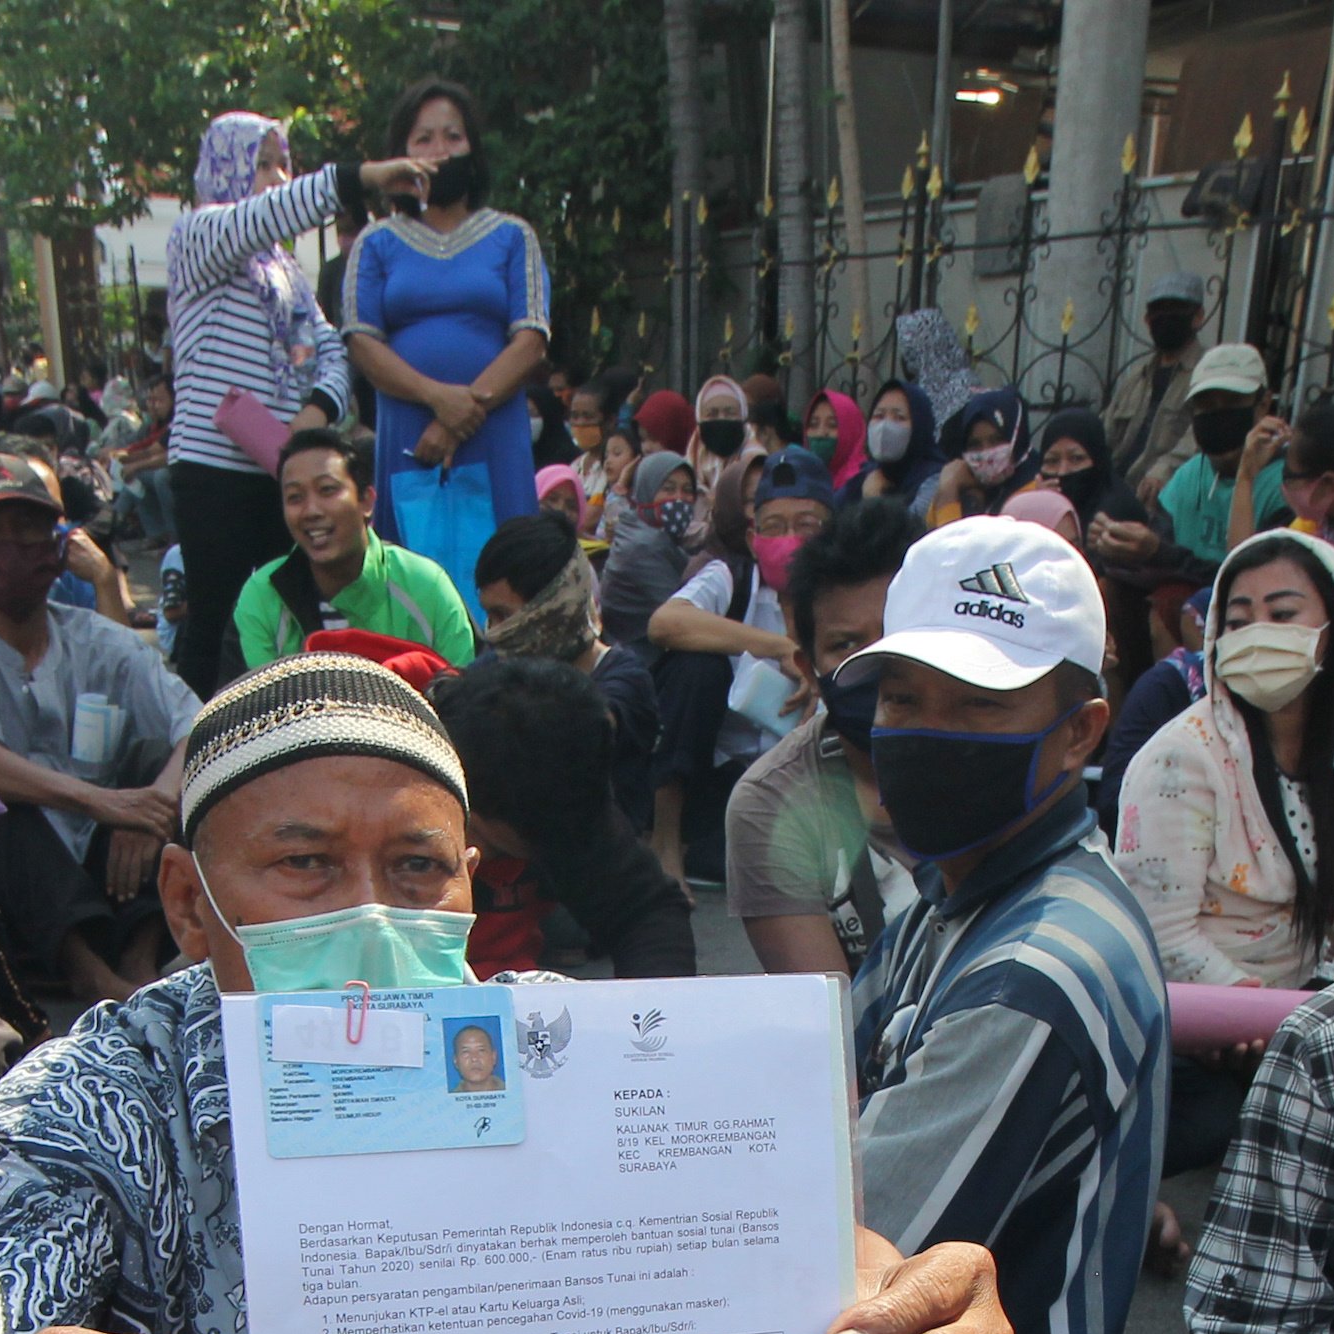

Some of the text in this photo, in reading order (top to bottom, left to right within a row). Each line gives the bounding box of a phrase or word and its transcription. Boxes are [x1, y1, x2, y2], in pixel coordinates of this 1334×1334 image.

[954, 600, 1025, 629] adidas
[382, 993, 407, 1001] JAWA
[408, 992, 434, 1000] TIMUR
[378, 1001, 423, 1010] SURABAYA
[614, 1089, 664, 1101] KEPADA
[615, 1106, 666, 1118] SUKILAN
[617, 1123, 670, 1135] KALIANAK
[676, 1121, 709, 1132] TIMUR
[618, 1131, 776, 1148] 8/19 KEL MOROKREMBANGAN
[618, 1143, 777, 1161] KEC KREMBANGAN KOTA
[619, 1161, 677, 1174] SURABAYA
[299, 1224, 345, 1236] Dengan
[300, 1235, 374, 1249] Berdasarkan
[377, 1232, 439, 1246] Keputusan
[443, 1226, 507, 1240] Pemerintah
[510, 1223, 558, 1238] Republik
[562, 1220, 613, 1232] Indonesia
[639, 1214, 698, 1226] Kementrian
[702, 1211, 733, 1223] Sosial
[736, 1208, 779, 1224] Republik
[457, 1240, 517, 1255] dinyatakan
[520, 1237, 558, 1249] berhak
[562, 1232, 628, 1247] memperoleh
[631, 1230, 674, 1241] bantuan
[678, 1226, 707, 1238] sosial
[710, 1226, 736, 1236] tunai
[739, 1223, 779, 1235] (Bansos
[304, 1265, 335, 1278] Tunai
[342, 1264, 377, 1275] Tahun
[381, 1260, 415, 1273] 2020)
[419, 1258, 456, 1270] senilai
[461, 1256, 479, 1269] Rp.
[542, 1250, 577, 1263] (Enam
[582, 1248, 609, 1258] ratus
[613, 1246, 632, 1256] ribu
[637, 1242, 673, 1256] rupiah)
[677, 1240, 708, 1252] setiap
[712, 1238, 740, 1249] bulan
[744, 1236, 780, 1247] selama
[303, 1282, 324, 1295] tiga
[304, 1292, 351, 1307] Adapun
[352, 1290, 420, 1306] persyaratan
[423, 1280, 562, 1301] pengambilan/penerimaan
[565, 1276, 604, 1287] Bansos
[609, 1272, 637, 1284] Tunai
[639, 1271, 651, 1280] ini
[654, 1268, 688, 1280] adalah
[336, 1310, 406, 1324] Menunjukan
[410, 1306, 449, 1319] KTP-el
[452, 1305, 476, 1316] atau
[480, 1302, 509, 1313] Kartu
[512, 1299, 561, 1314] Keluarga
[428, 1319, 484, 1331] ketentuan
[487, 1313, 554, 1329] pencegahan
[556, 1307, 603, 1321] Covid-19
[606, 1301, 683, 1319] (menggunakan
